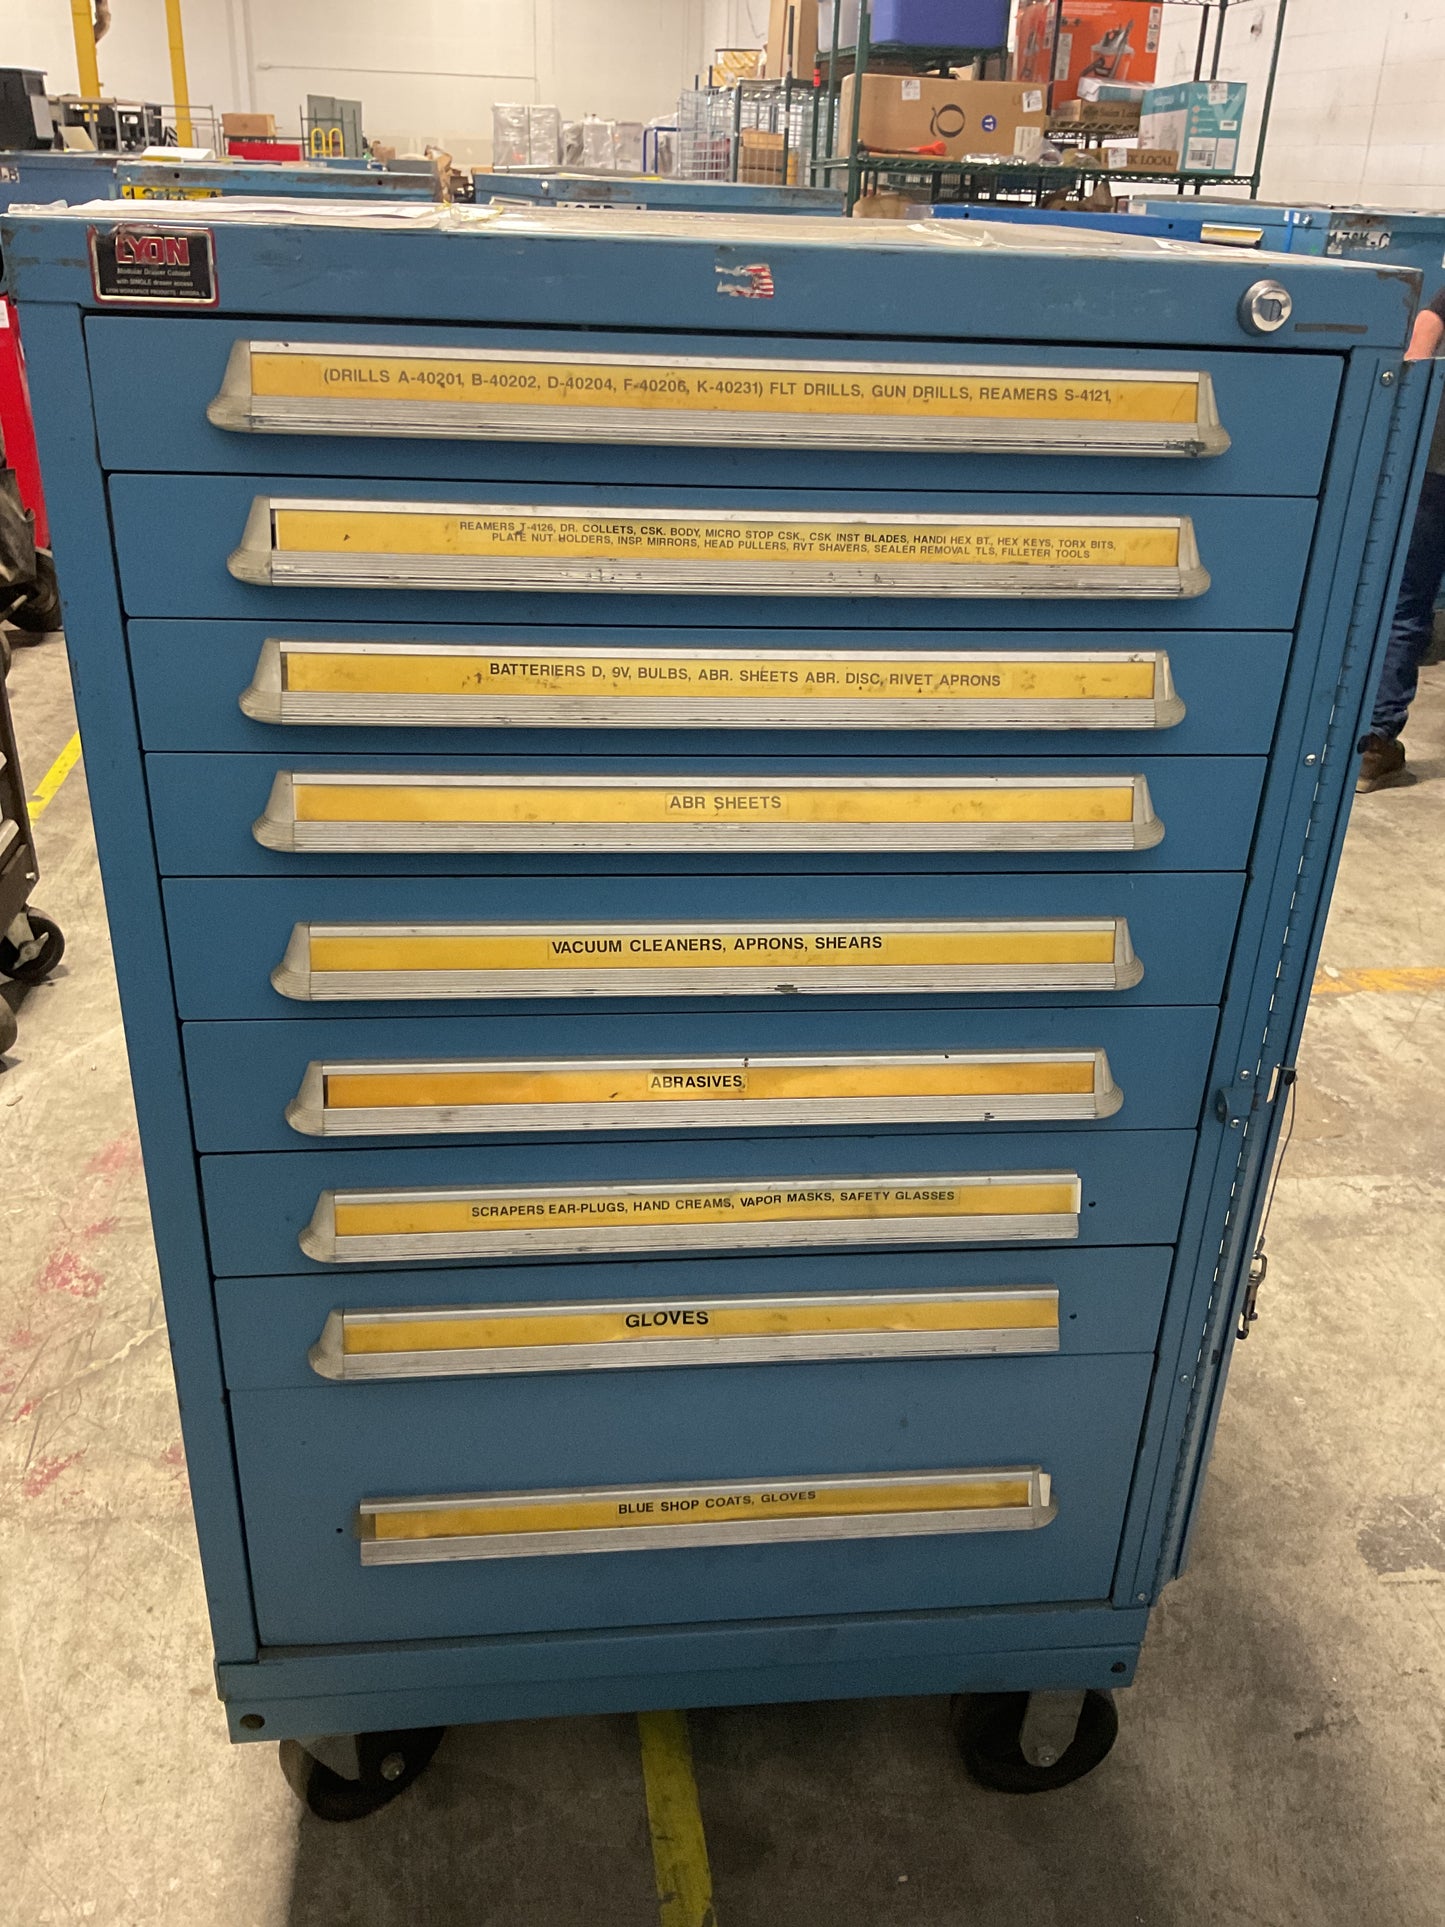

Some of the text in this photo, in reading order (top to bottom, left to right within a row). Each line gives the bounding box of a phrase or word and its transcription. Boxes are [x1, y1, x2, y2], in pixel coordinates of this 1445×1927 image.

[115, 236, 190, 266] LYON
[324, 368, 1112, 404] (DRILLS A-40201, B-40202, D-40204, F-40206, K-40231) FLT DRILLS, GUN DRILLS, REAMERS S-4121,
[460, 521, 515, 532] REAMERS
[560, 524, 578, 533] DR.
[582, 524, 636, 536] COLLETS,
[640, 526, 666, 536] CSK.
[671, 528, 700, 538] BODY,
[705, 528, 741, 539] MICRO
[745, 530, 774, 540] STOP
[810, 532, 832, 542] CSK
[836, 534, 860, 542] INST
[864, 534, 910, 544] BLADES,
[914, 535, 946, 544] HANDI
[950, 536, 972, 545] HEX
[998, 537, 1018, 546] HEX
[1023, 538, 1054, 548] KEYS,
[1059, 540, 1086, 549] TORX
[1091, 540, 1116, 550] BITS,
[492, 532, 527, 542] PLATE
[532, 532, 553, 543] NUT
[558, 534, 613, 545] HOLDERS,
[647, 537, 700, 548] MIRRORS,
[704, 540, 734, 549] HEAD
[738, 540, 789, 551] PULLERS,
[793, 542, 814, 551] RVT
[818, 542, 870, 554] SHAVERS,
[874, 544, 916, 554] SEALER
[920, 546, 970, 555] REMOVAL
[976, 546, 998, 556] TLS,
[1002, 548, 1050, 557] FILLETER
[1056, 550, 1090, 559] TOOLS
[490, 663, 1000, 686] BATTERIERS D, 9V, BULBS, ABR. SHEETS ABR. DISC, RIVET APRONS
[670, 796, 782, 810] ABR SHEETS
[552, 936, 882, 954] VACUUM CLEANERS, APRONS, SHEARS
[651, 1075, 743, 1088] ABRASIVES
[472, 1190, 955, 1217] SCRAPERS EAR-PLUGS, HAND CREAMS, VAPOR MASKS, SAFETY GLASSES
[626, 1311, 709, 1328] GLOVES
[618, 1490, 816, 1514] BLUE SHOP COATS, GLOVES
